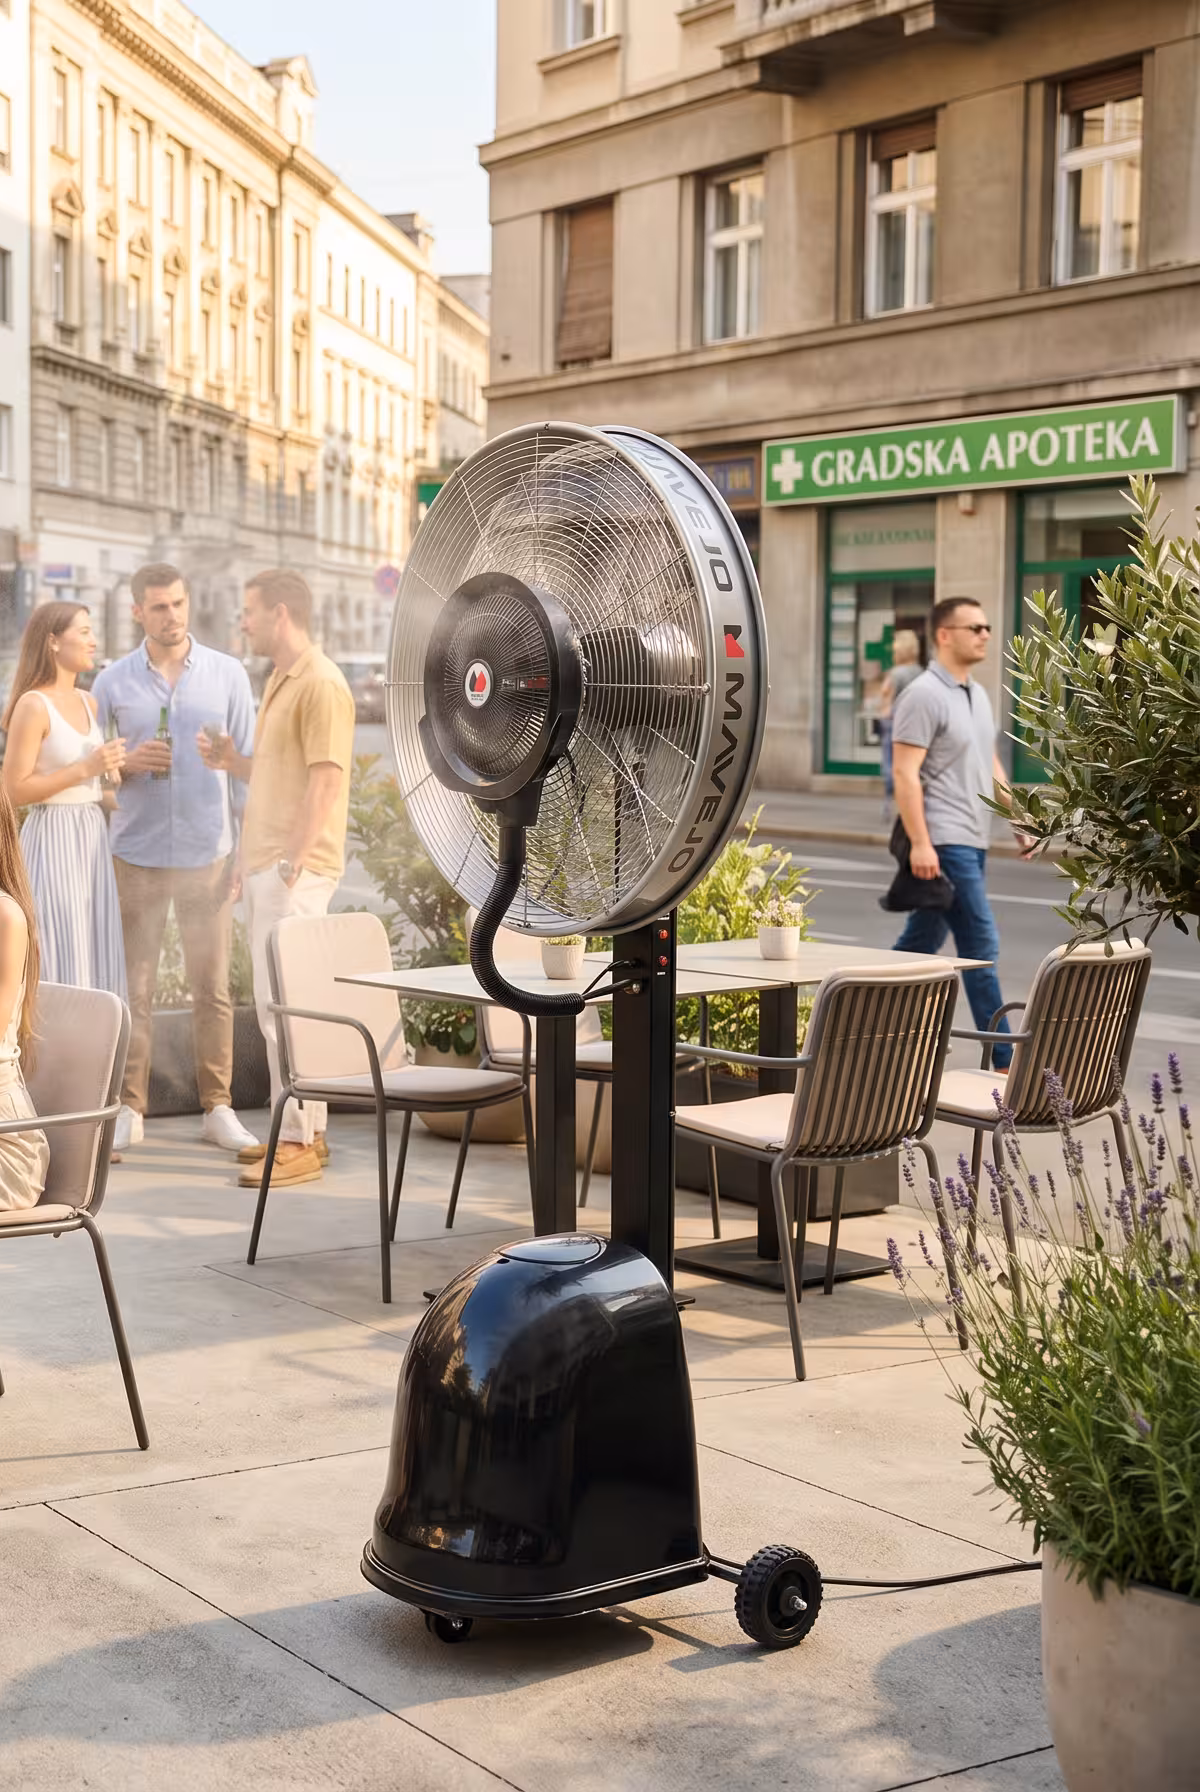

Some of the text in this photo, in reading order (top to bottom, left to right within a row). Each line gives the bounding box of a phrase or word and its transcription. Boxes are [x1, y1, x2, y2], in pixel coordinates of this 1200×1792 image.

[811, 417, 1160, 487] GRADSKA APOTEKA
[668, 673, 744, 872] MAVEJO
